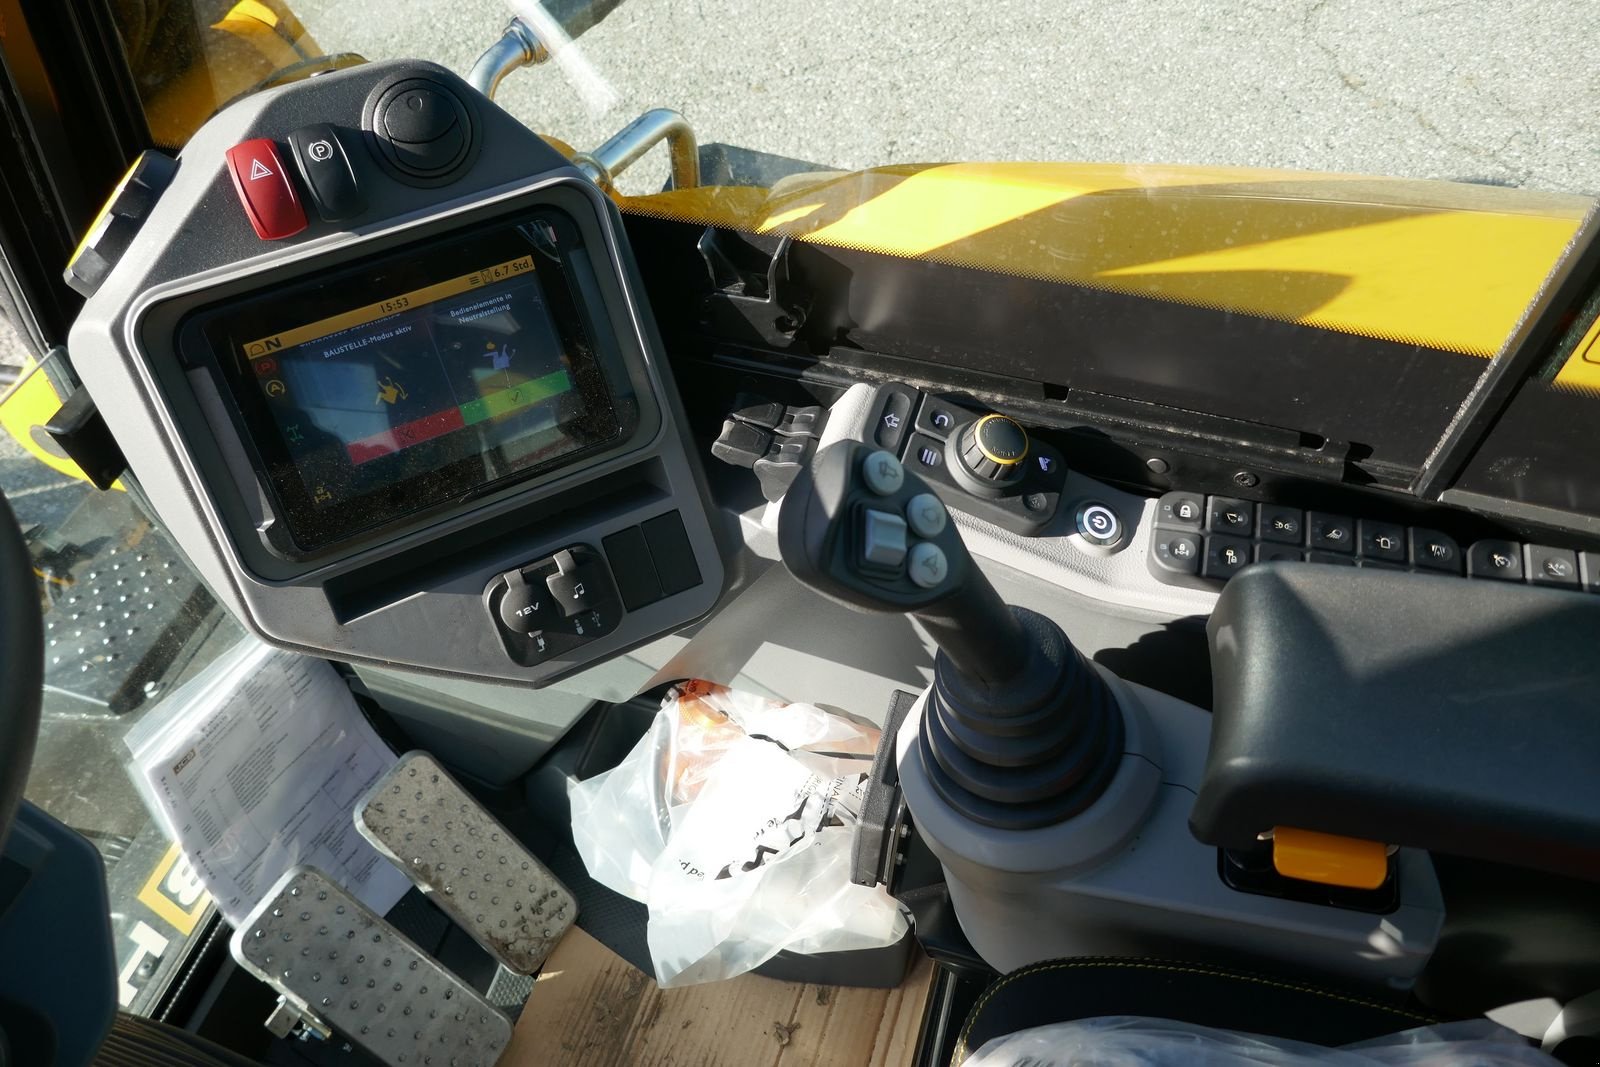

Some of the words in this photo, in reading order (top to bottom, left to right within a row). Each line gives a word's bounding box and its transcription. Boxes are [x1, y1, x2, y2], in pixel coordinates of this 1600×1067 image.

[494, 265, 509, 278] 6.7
[512, 259, 533, 272] Std.
[380, 297, 409, 313] 15:53
[450, 296, 504, 318] Bedienelemente
[265, 337, 282, 351] N
[323, 331, 394, 359] BAUSTELLE-Modus
[395, 324, 413, 336] aktiv
[515, 602, 539, 617] 12V
